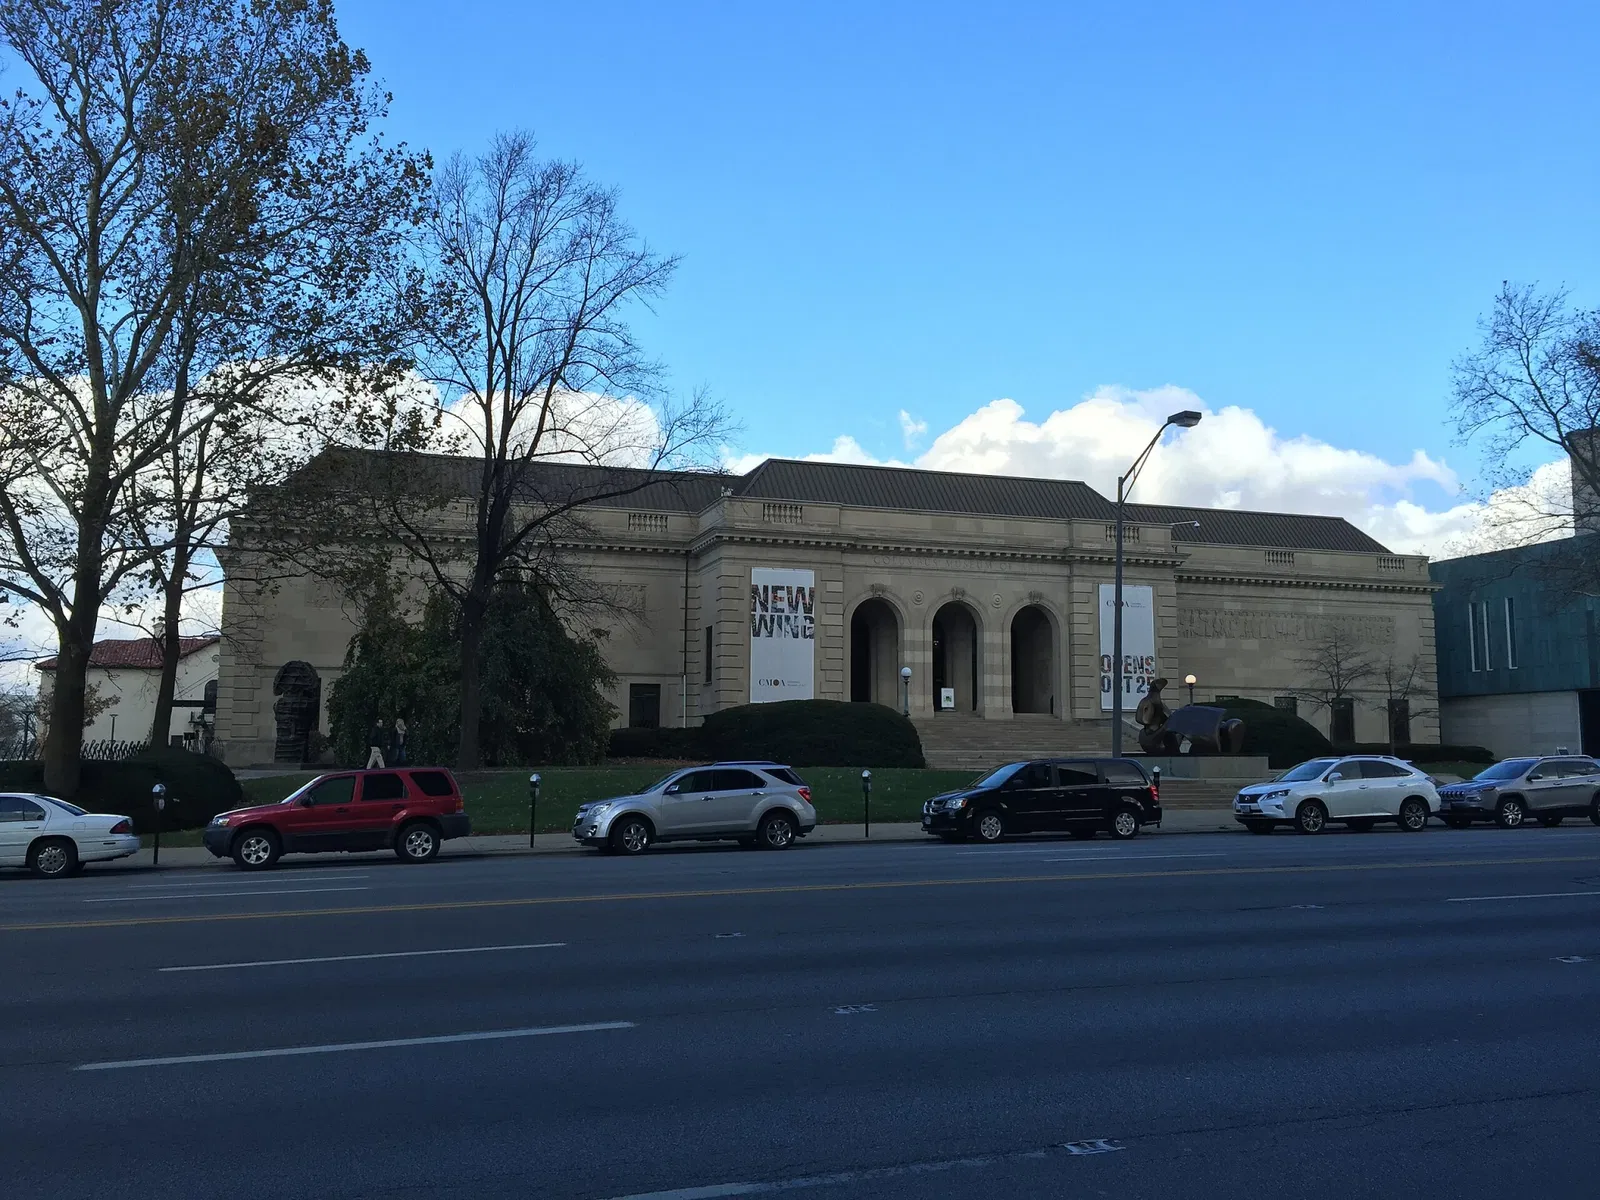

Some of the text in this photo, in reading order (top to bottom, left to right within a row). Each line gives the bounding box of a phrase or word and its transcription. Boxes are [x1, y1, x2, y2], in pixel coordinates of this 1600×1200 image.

[873, 555, 938, 567] COLUMBUS
[751, 584, 815, 614] NEW
[751, 614, 815, 639] WING
[1100, 654, 1155, 675] OENS
[1100, 675, 1133, 693] OT
